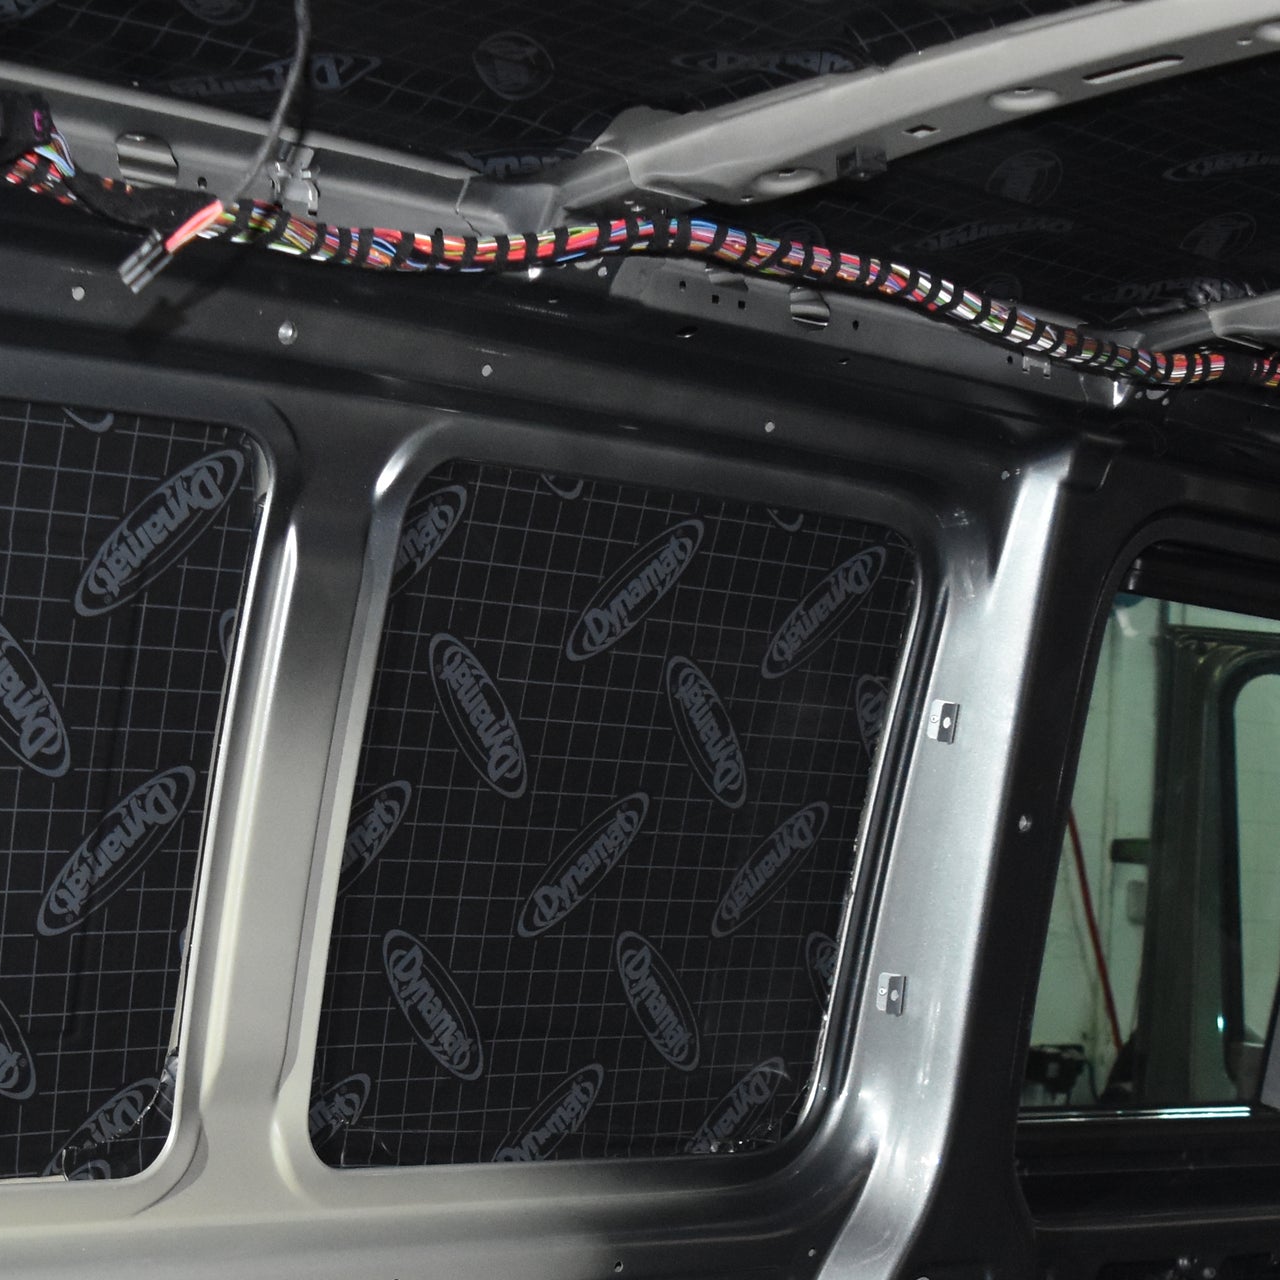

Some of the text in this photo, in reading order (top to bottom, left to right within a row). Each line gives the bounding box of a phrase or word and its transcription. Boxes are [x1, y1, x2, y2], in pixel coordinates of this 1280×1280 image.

[88, 458, 225, 598] Dynamat
[583, 534, 694, 650] Dynamat
[772, 554, 872, 663] Dynamat
[440, 645, 522, 784] Dynamat
[674, 666, 741, 794] Dynamat
[48, 776, 178, 916] Dynamat
[533, 809, 639, 927] Dynamat
[720, 809, 816, 920] Dynamat
[389, 943, 477, 1071] Dynamat
[621, 946, 694, 1062] Dynamat
